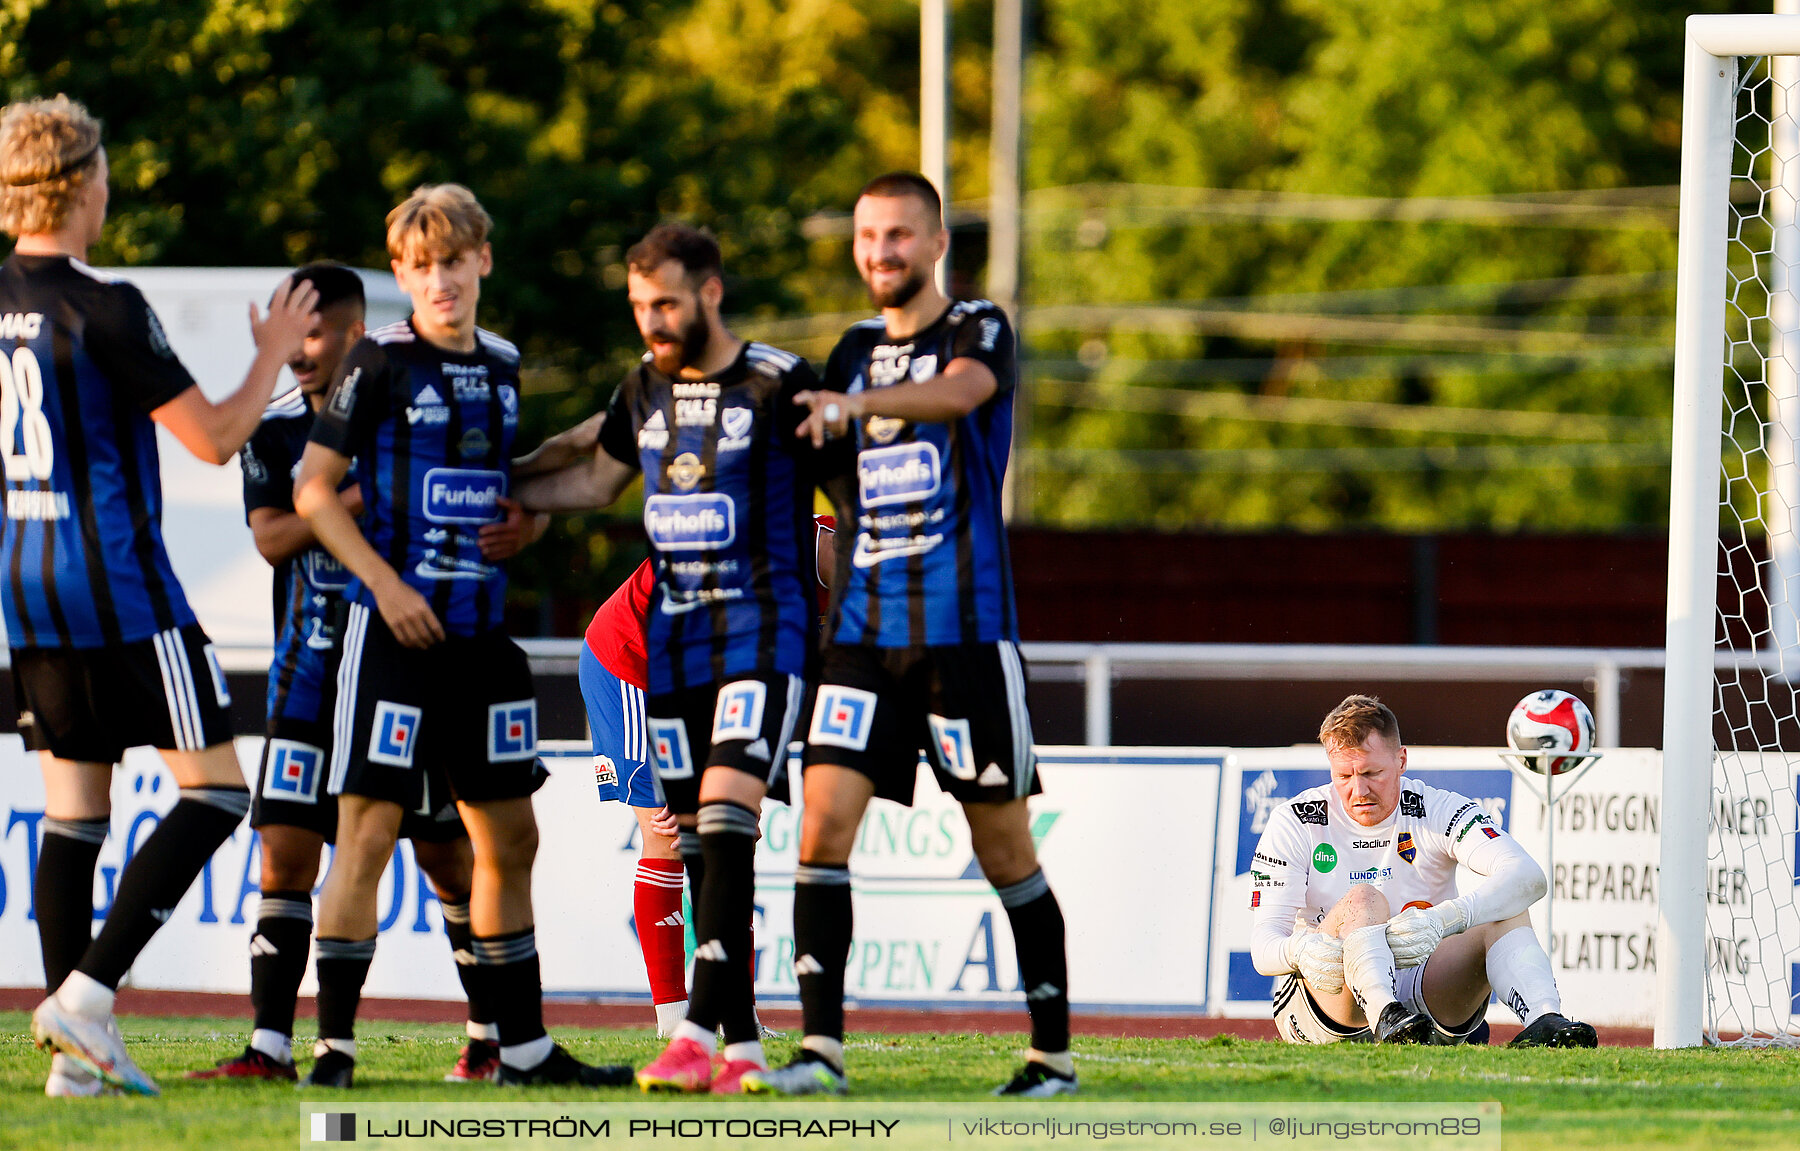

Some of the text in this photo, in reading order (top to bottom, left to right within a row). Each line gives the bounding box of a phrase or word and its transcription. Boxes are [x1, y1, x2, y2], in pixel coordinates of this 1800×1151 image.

[432, 483, 497, 507] Furhoff
[1294, 801, 1326, 816] LOK
[1314, 851, 1335, 863] dina
